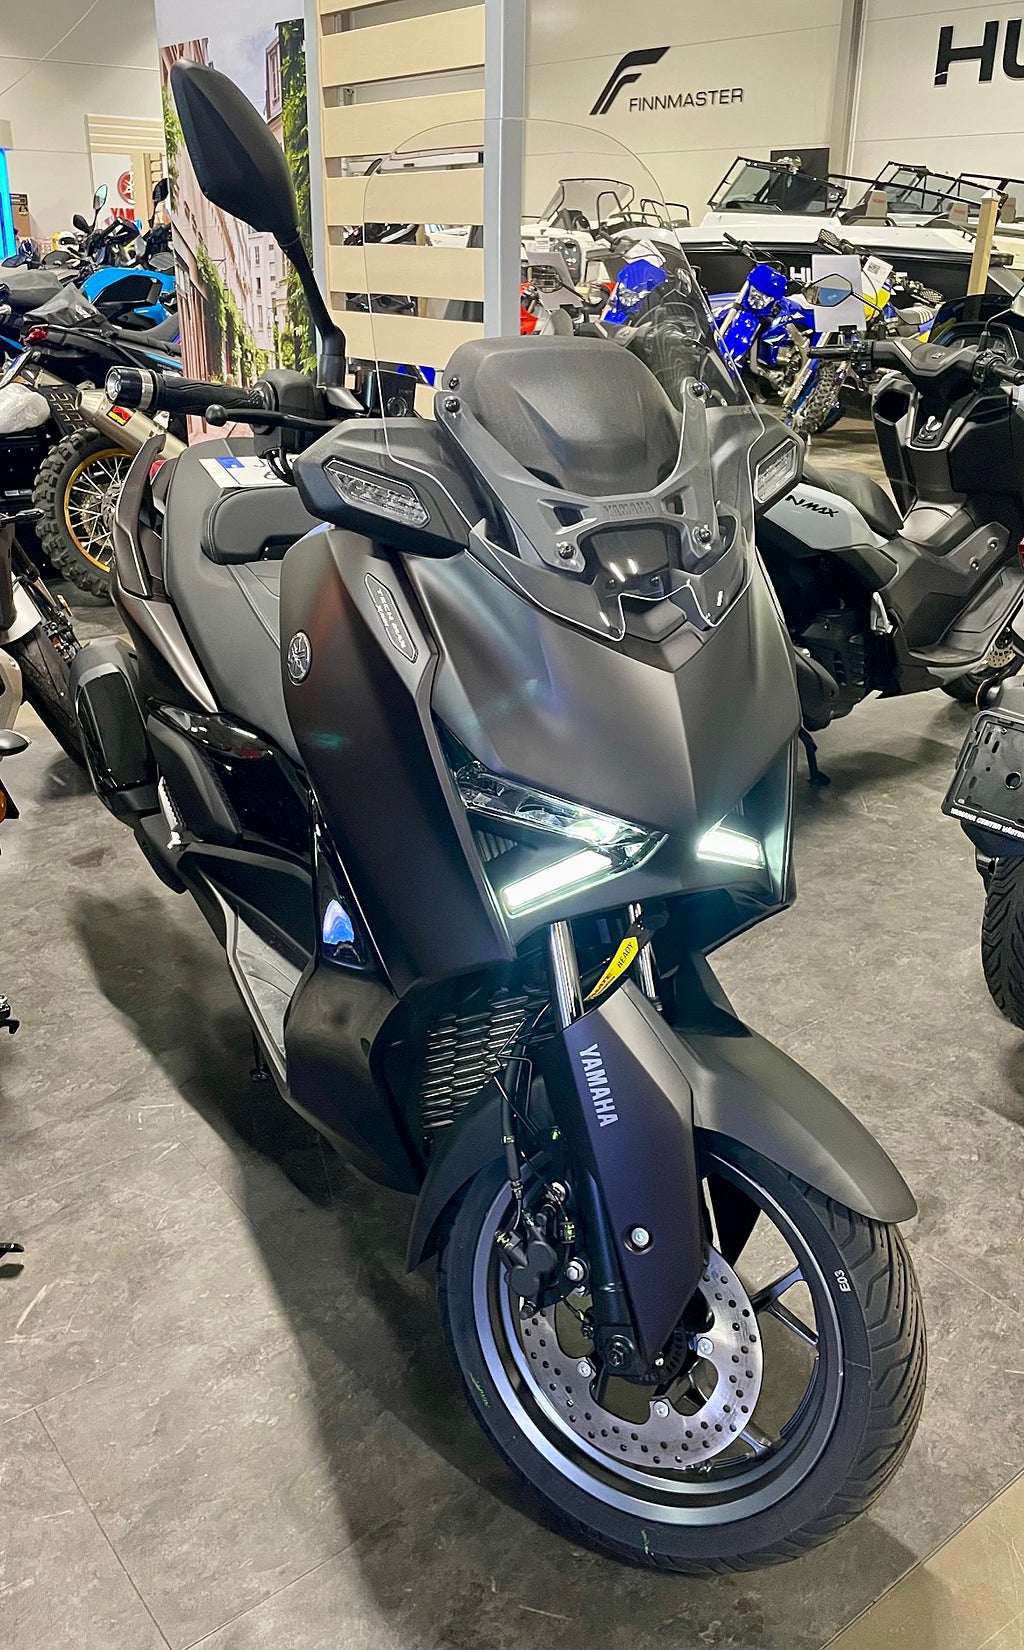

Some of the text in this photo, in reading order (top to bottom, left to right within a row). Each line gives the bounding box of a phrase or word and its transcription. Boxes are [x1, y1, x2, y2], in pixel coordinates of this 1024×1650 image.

[629, 87, 744, 113] FINNMASTER
[602, 500, 655, 517] YAMAHA
[785, 494, 839, 518] NMAX
[617, 941, 634, 969] READY
[579, 1043, 619, 1128] YAMAHA
[834, 1269, 852, 1292] E03
